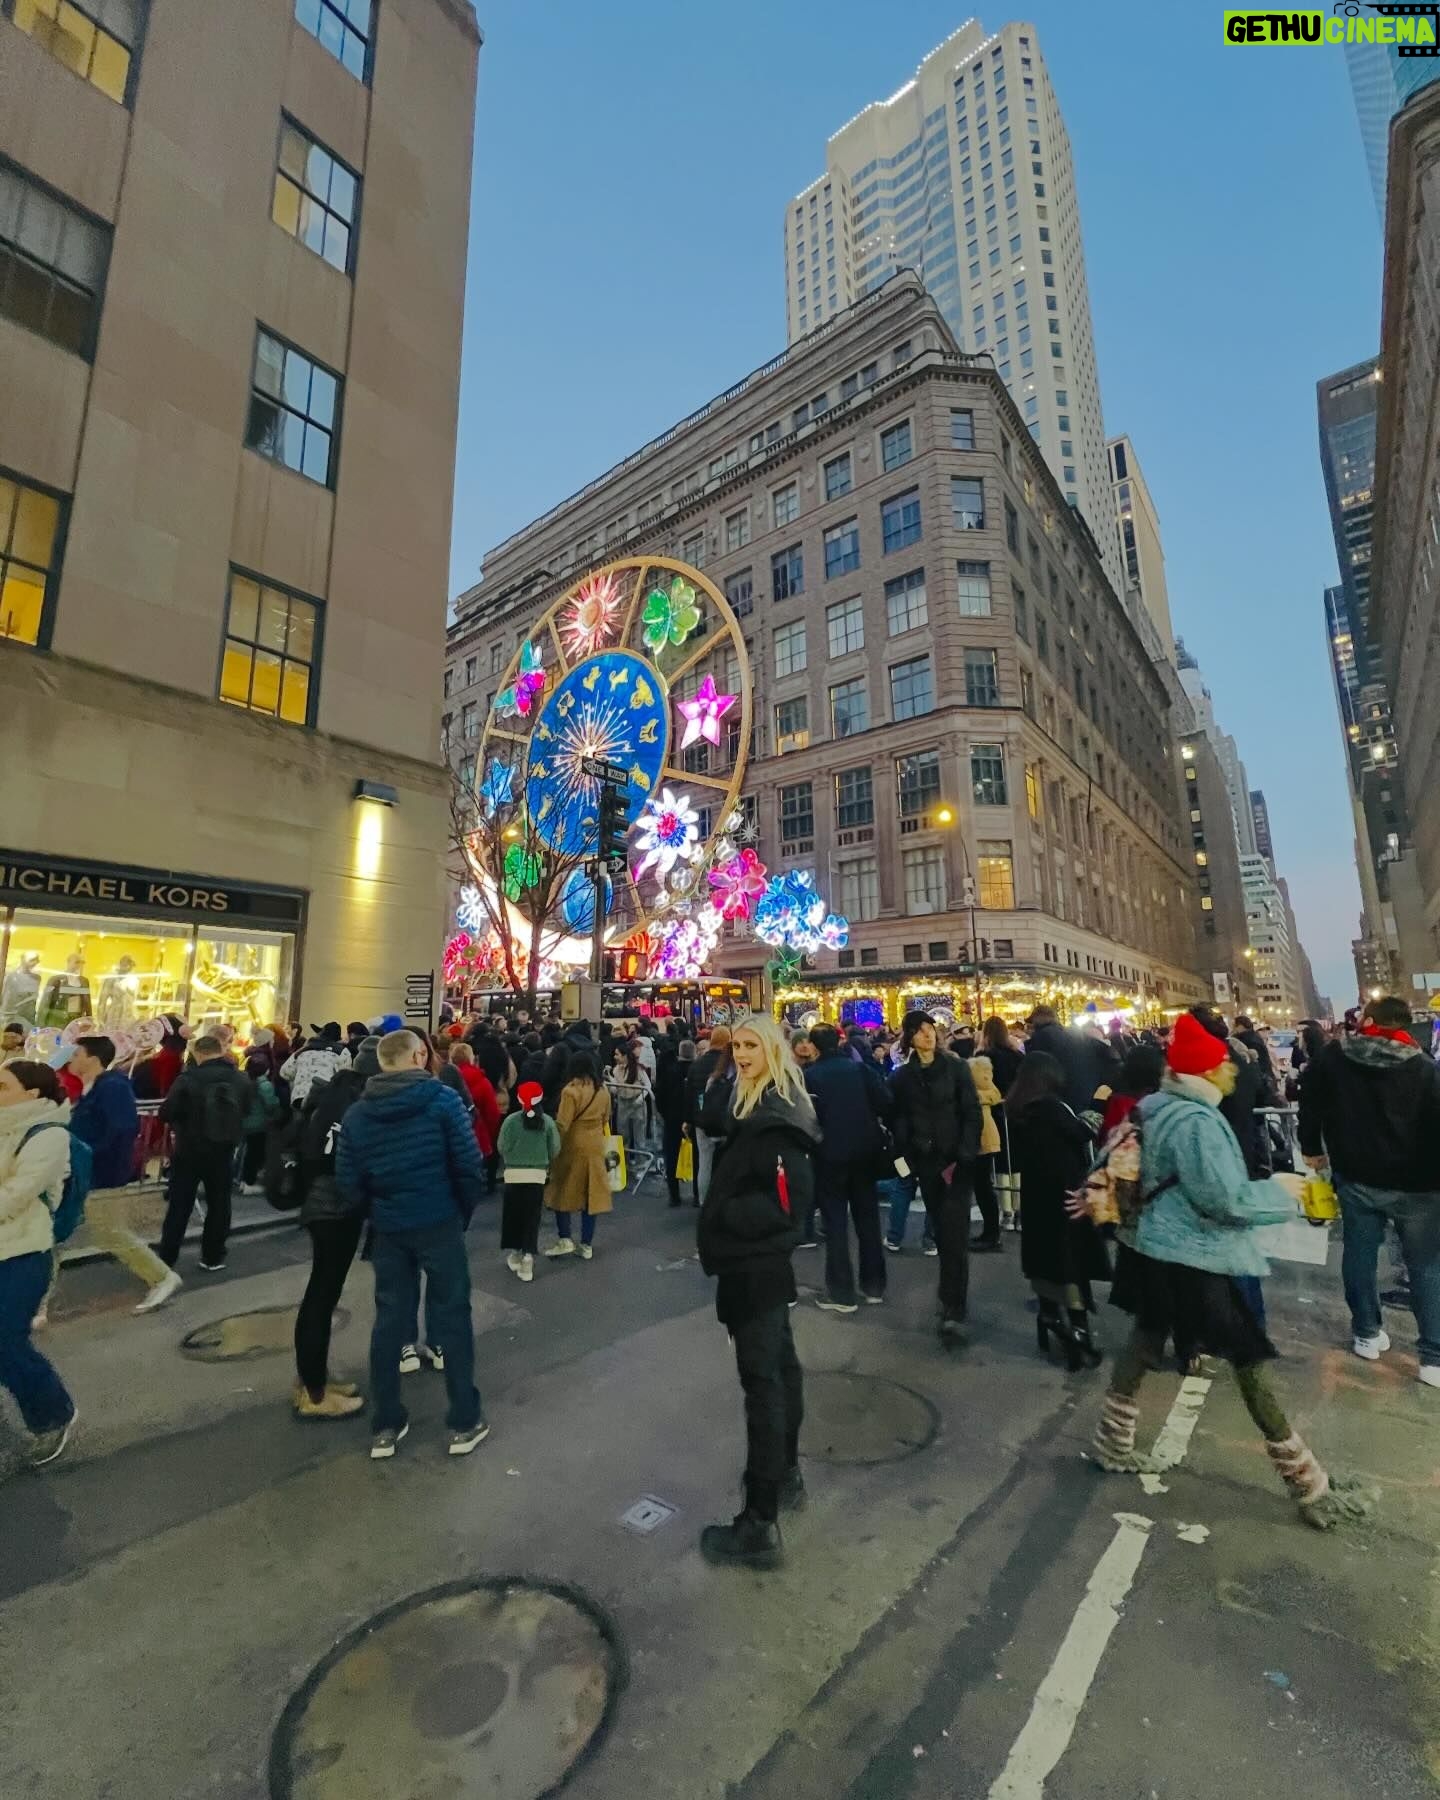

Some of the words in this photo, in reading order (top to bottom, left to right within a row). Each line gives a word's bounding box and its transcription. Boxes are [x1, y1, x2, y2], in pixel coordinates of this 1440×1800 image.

[586, 762, 603, 774] ONE
[0, 865, 134, 901] ICHAEL
[149, 884, 228, 911] KORS
